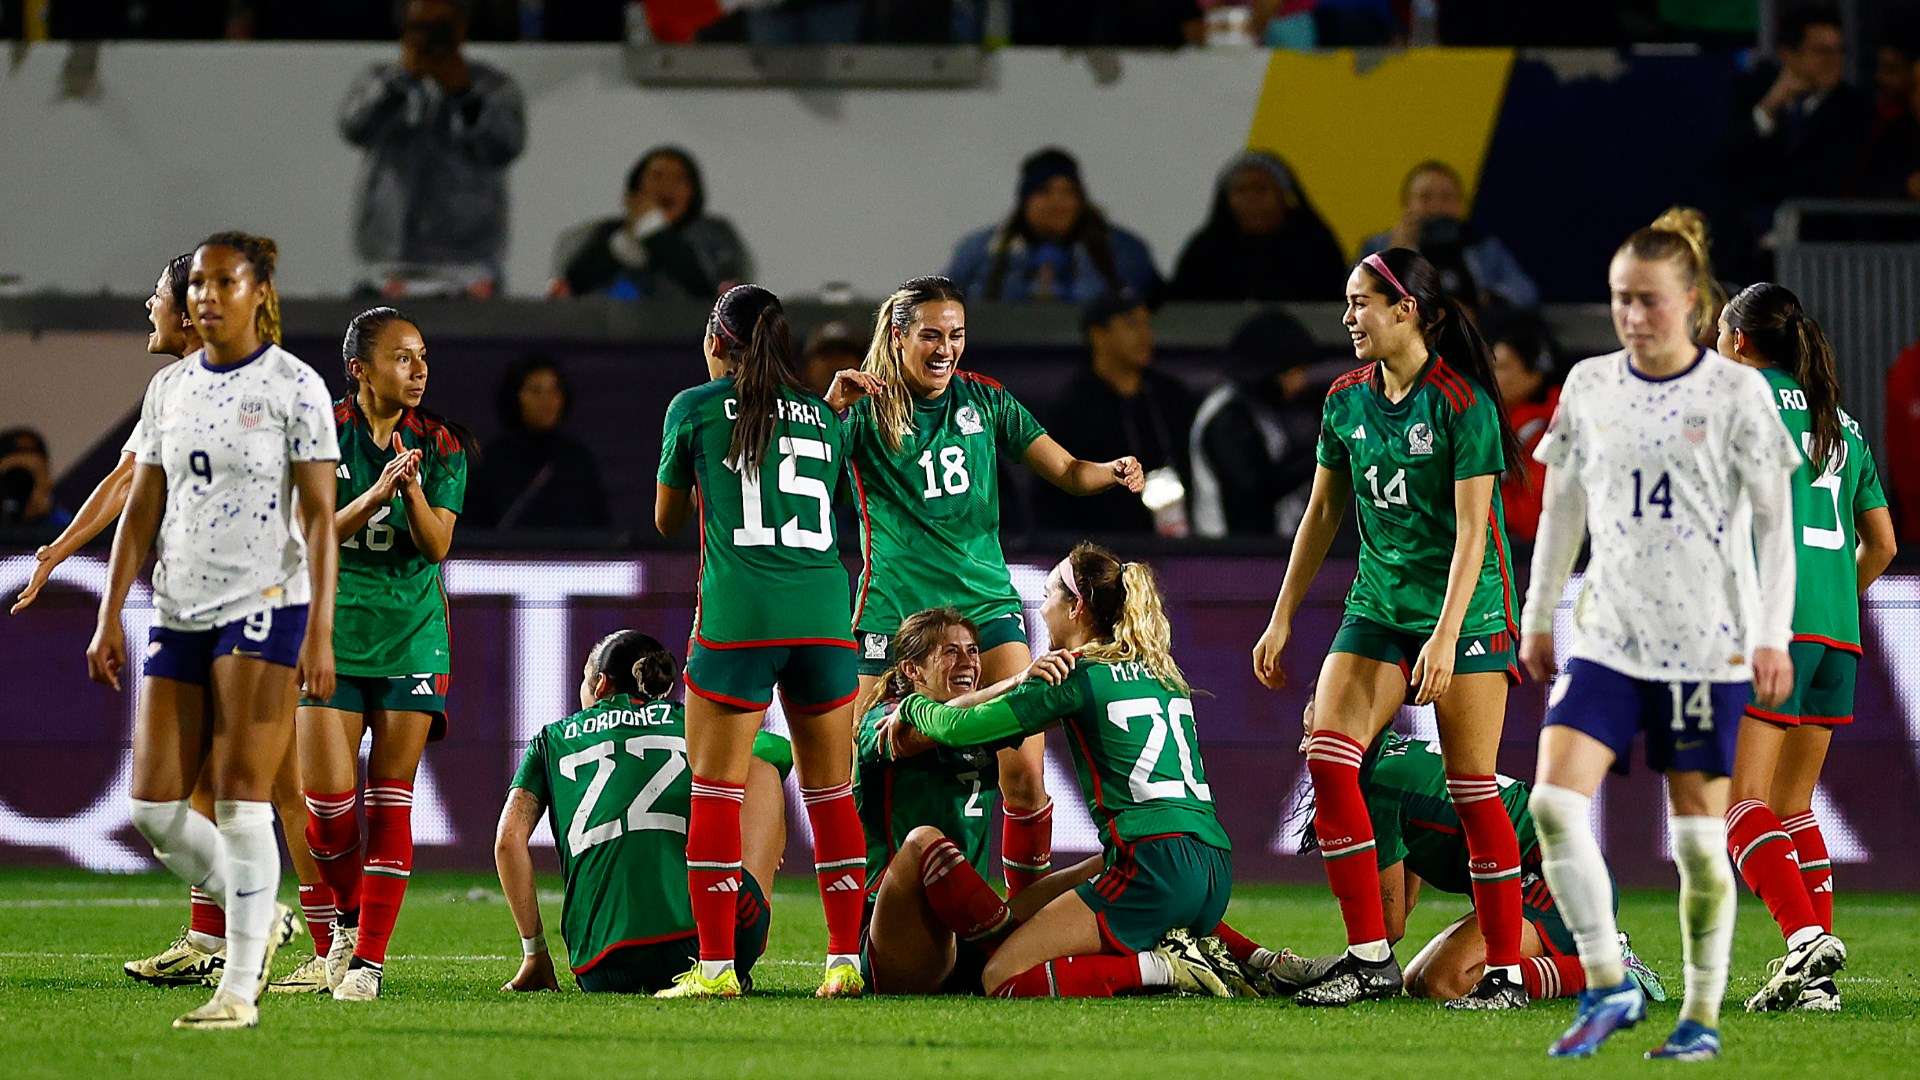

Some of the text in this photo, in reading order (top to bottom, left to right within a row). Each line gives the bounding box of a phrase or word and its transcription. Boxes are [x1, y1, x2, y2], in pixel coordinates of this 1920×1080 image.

[189, 449, 212, 496] 9
[722, 436, 834, 552] 15
[917, 445, 970, 499] 18
[1363, 465, 1408, 509] 14
[1631, 469, 1673, 519] 14
[243, 608, 273, 642] 9
[1668, 680, 1714, 730] 14
[1106, 697, 1212, 803] 20
[558, 734, 687, 858] 22
[956, 770, 983, 817] 2
